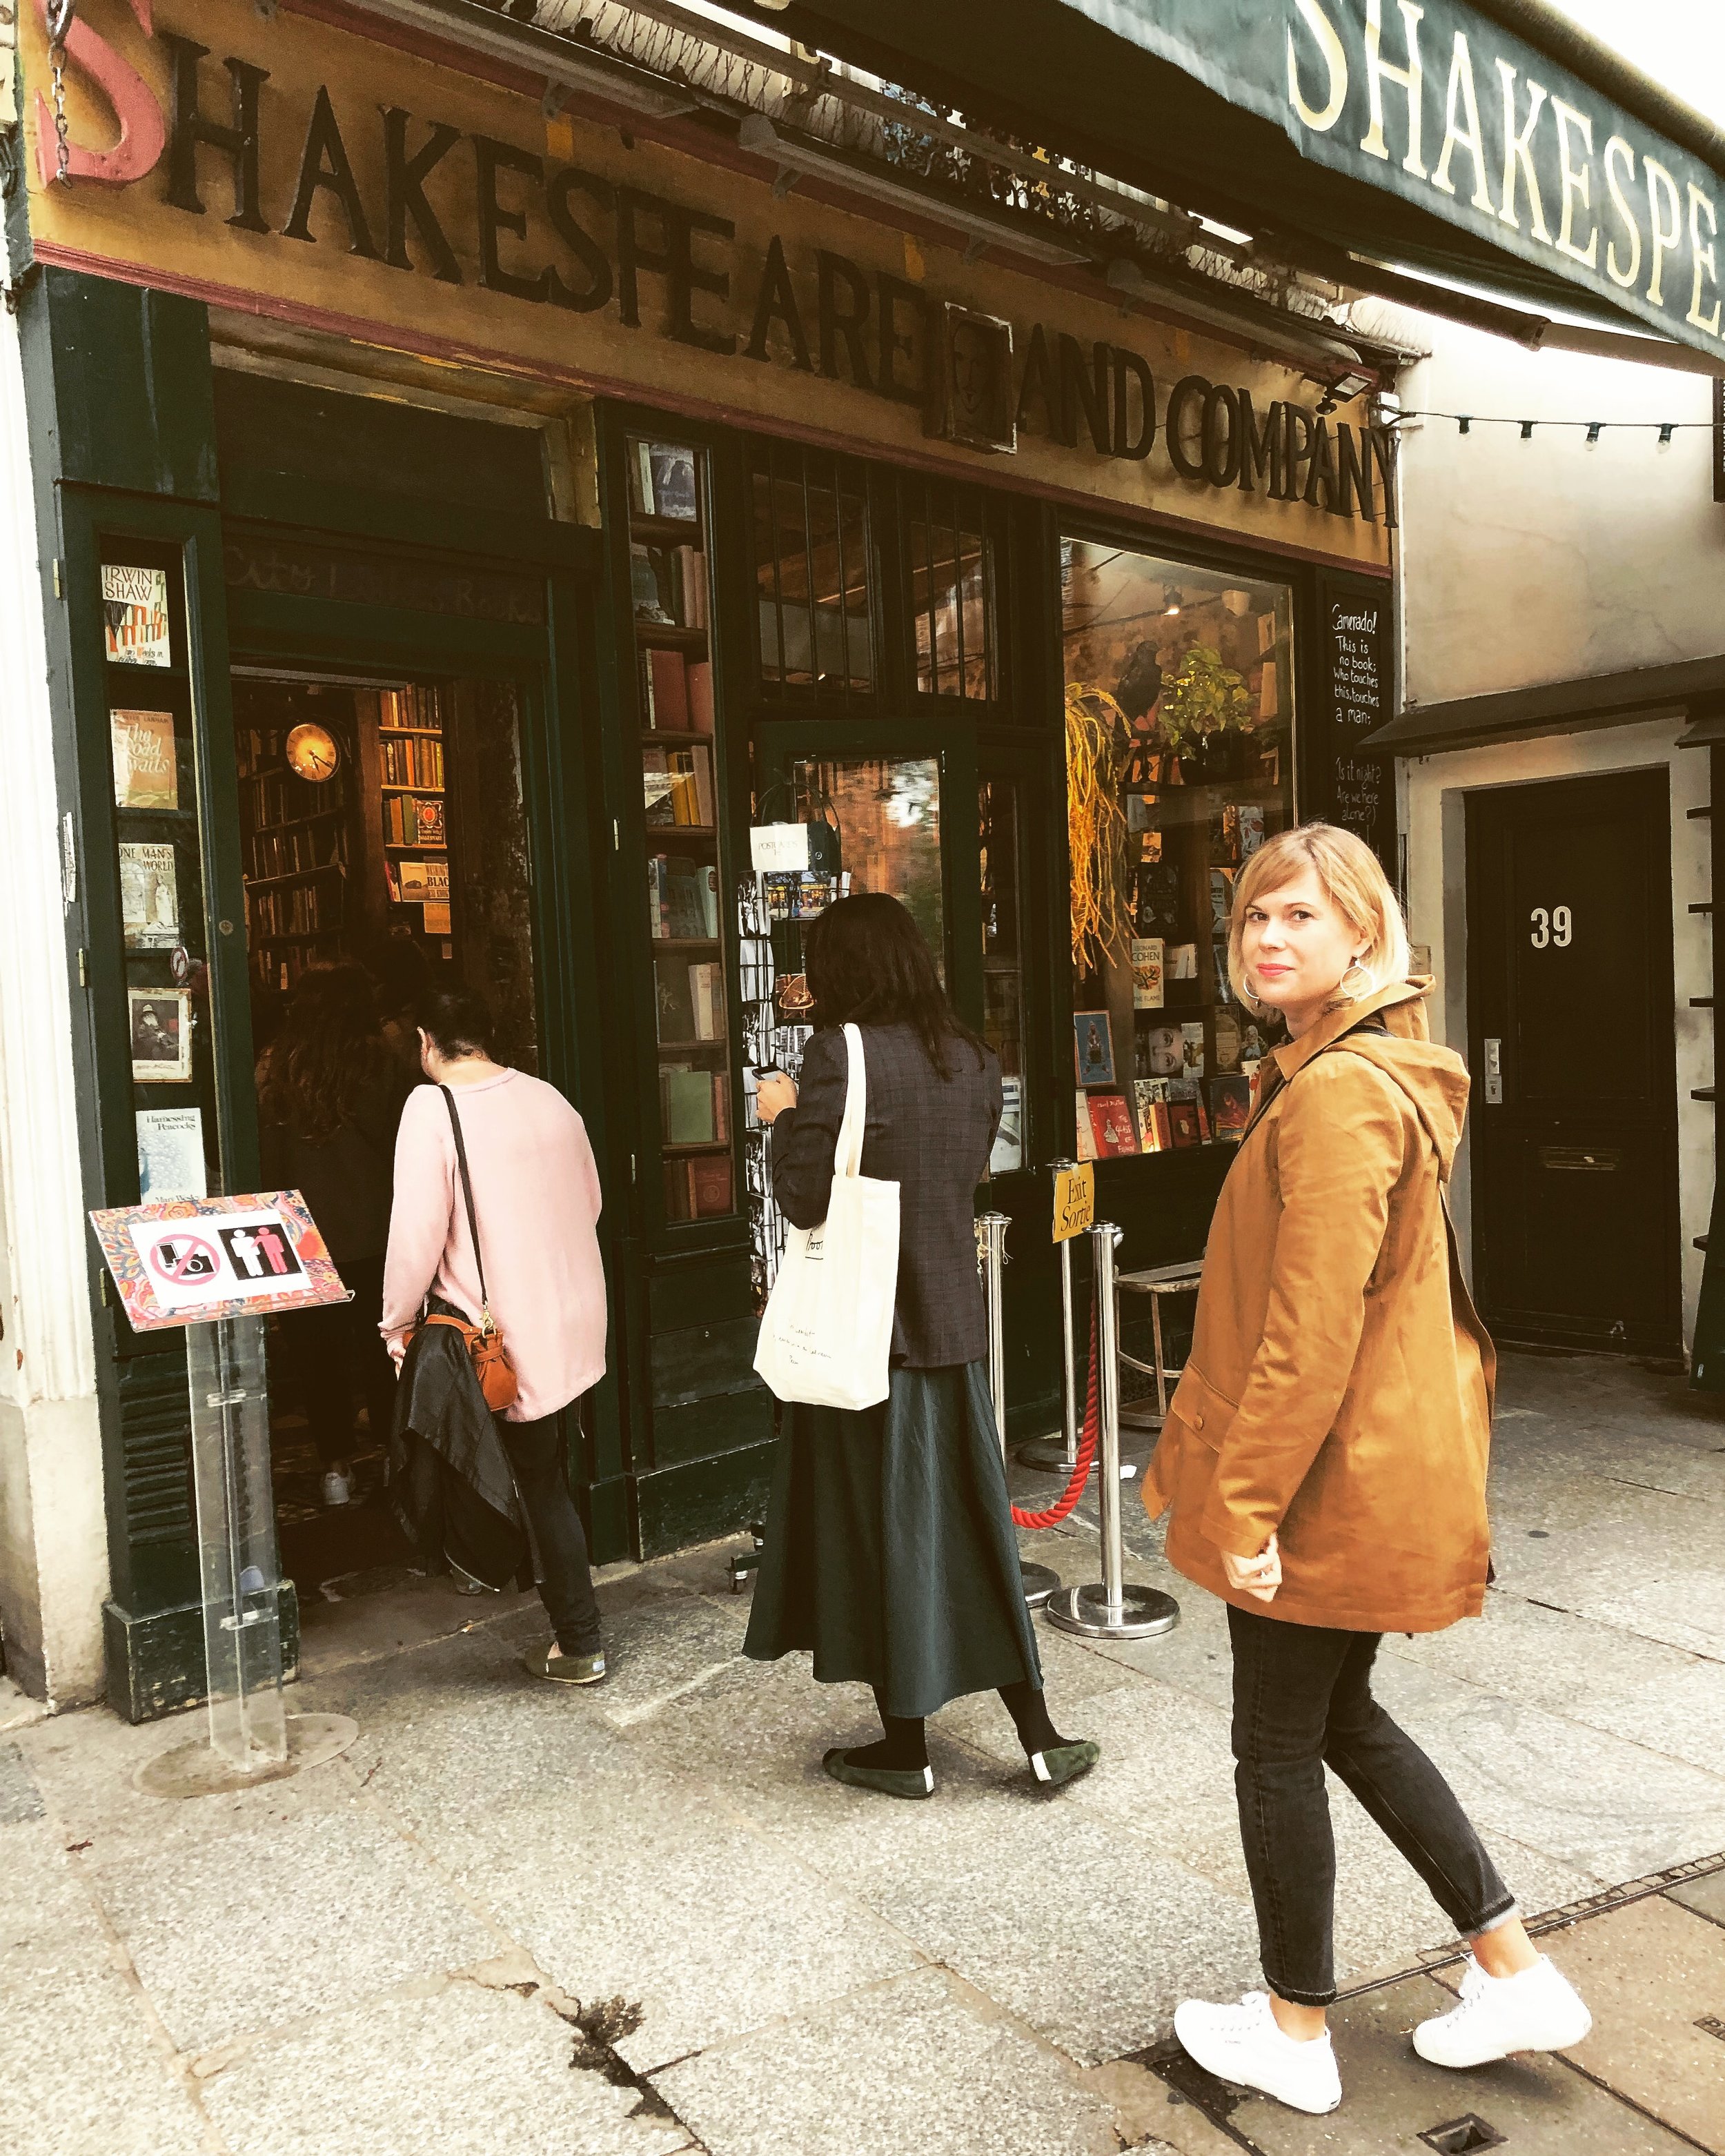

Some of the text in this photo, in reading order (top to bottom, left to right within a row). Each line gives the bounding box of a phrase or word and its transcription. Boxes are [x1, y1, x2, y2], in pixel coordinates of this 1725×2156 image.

[1288, 0, 1725, 338] SHAKESPE
[35, 0, 1399, 528] SHAKESPEARE AND COMPANY
[105, 565, 152, 585] IRWIN
[105, 581, 152, 601] SHAW
[1332, 604, 1377, 635] Camerado!
[1335, 635, 1369, 654] This is
[1339, 656, 1377, 673] no book;
[1350, 669, 1379, 689] touches
[1336, 707, 1372, 725] a man;
[143, 860, 173, 871] WORLD
[1530, 906, 1573, 949] 39
[1132, 952, 1160, 962] COHEN
[1067, 1175, 1087, 1205] Exit
[1061, 1201, 1092, 1232] Sortie
